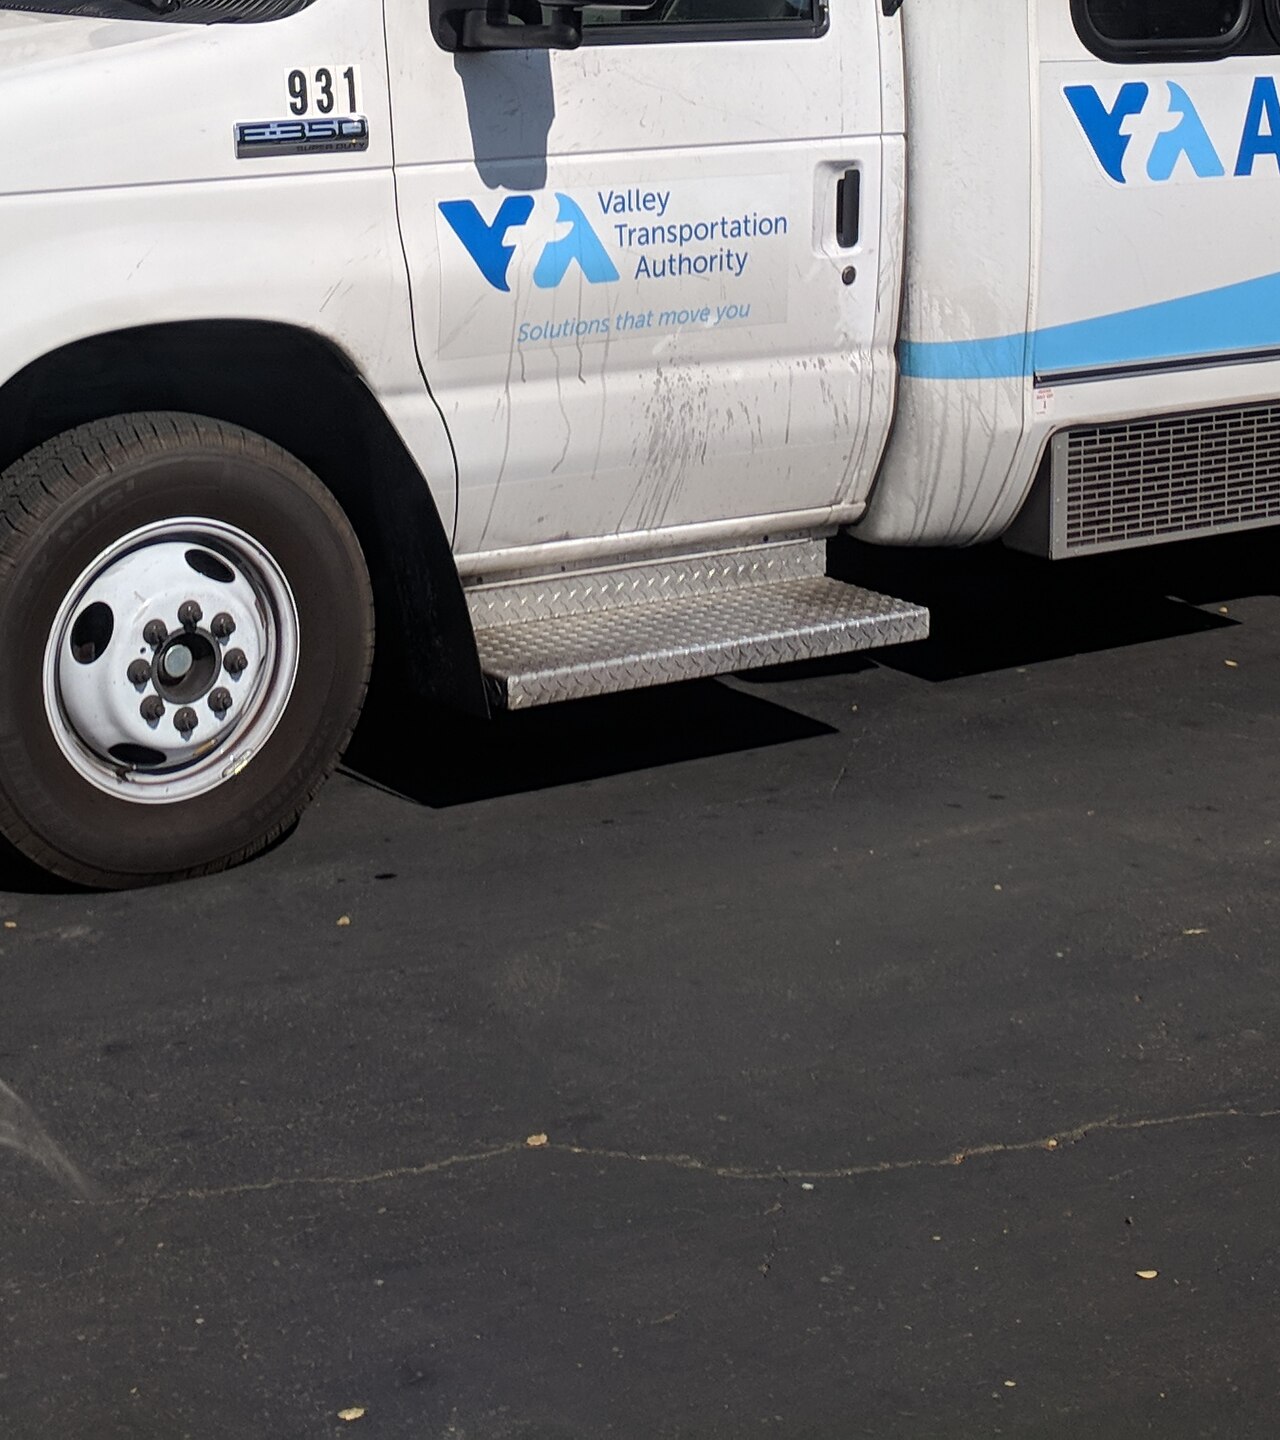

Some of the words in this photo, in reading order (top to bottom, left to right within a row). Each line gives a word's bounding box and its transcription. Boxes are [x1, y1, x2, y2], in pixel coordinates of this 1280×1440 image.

[287, 66, 357, 116] 931
[335, 142, 365, 150] DUTY
[597, 188, 671, 217] Valley
[614, 212, 788, 248] Transportation
[634, 247, 748, 280] Authority
[517, 317, 609, 343] Solutions
[616, 311, 652, 331] that
[658, 306, 710, 327] move
[715, 303, 751, 325] you
